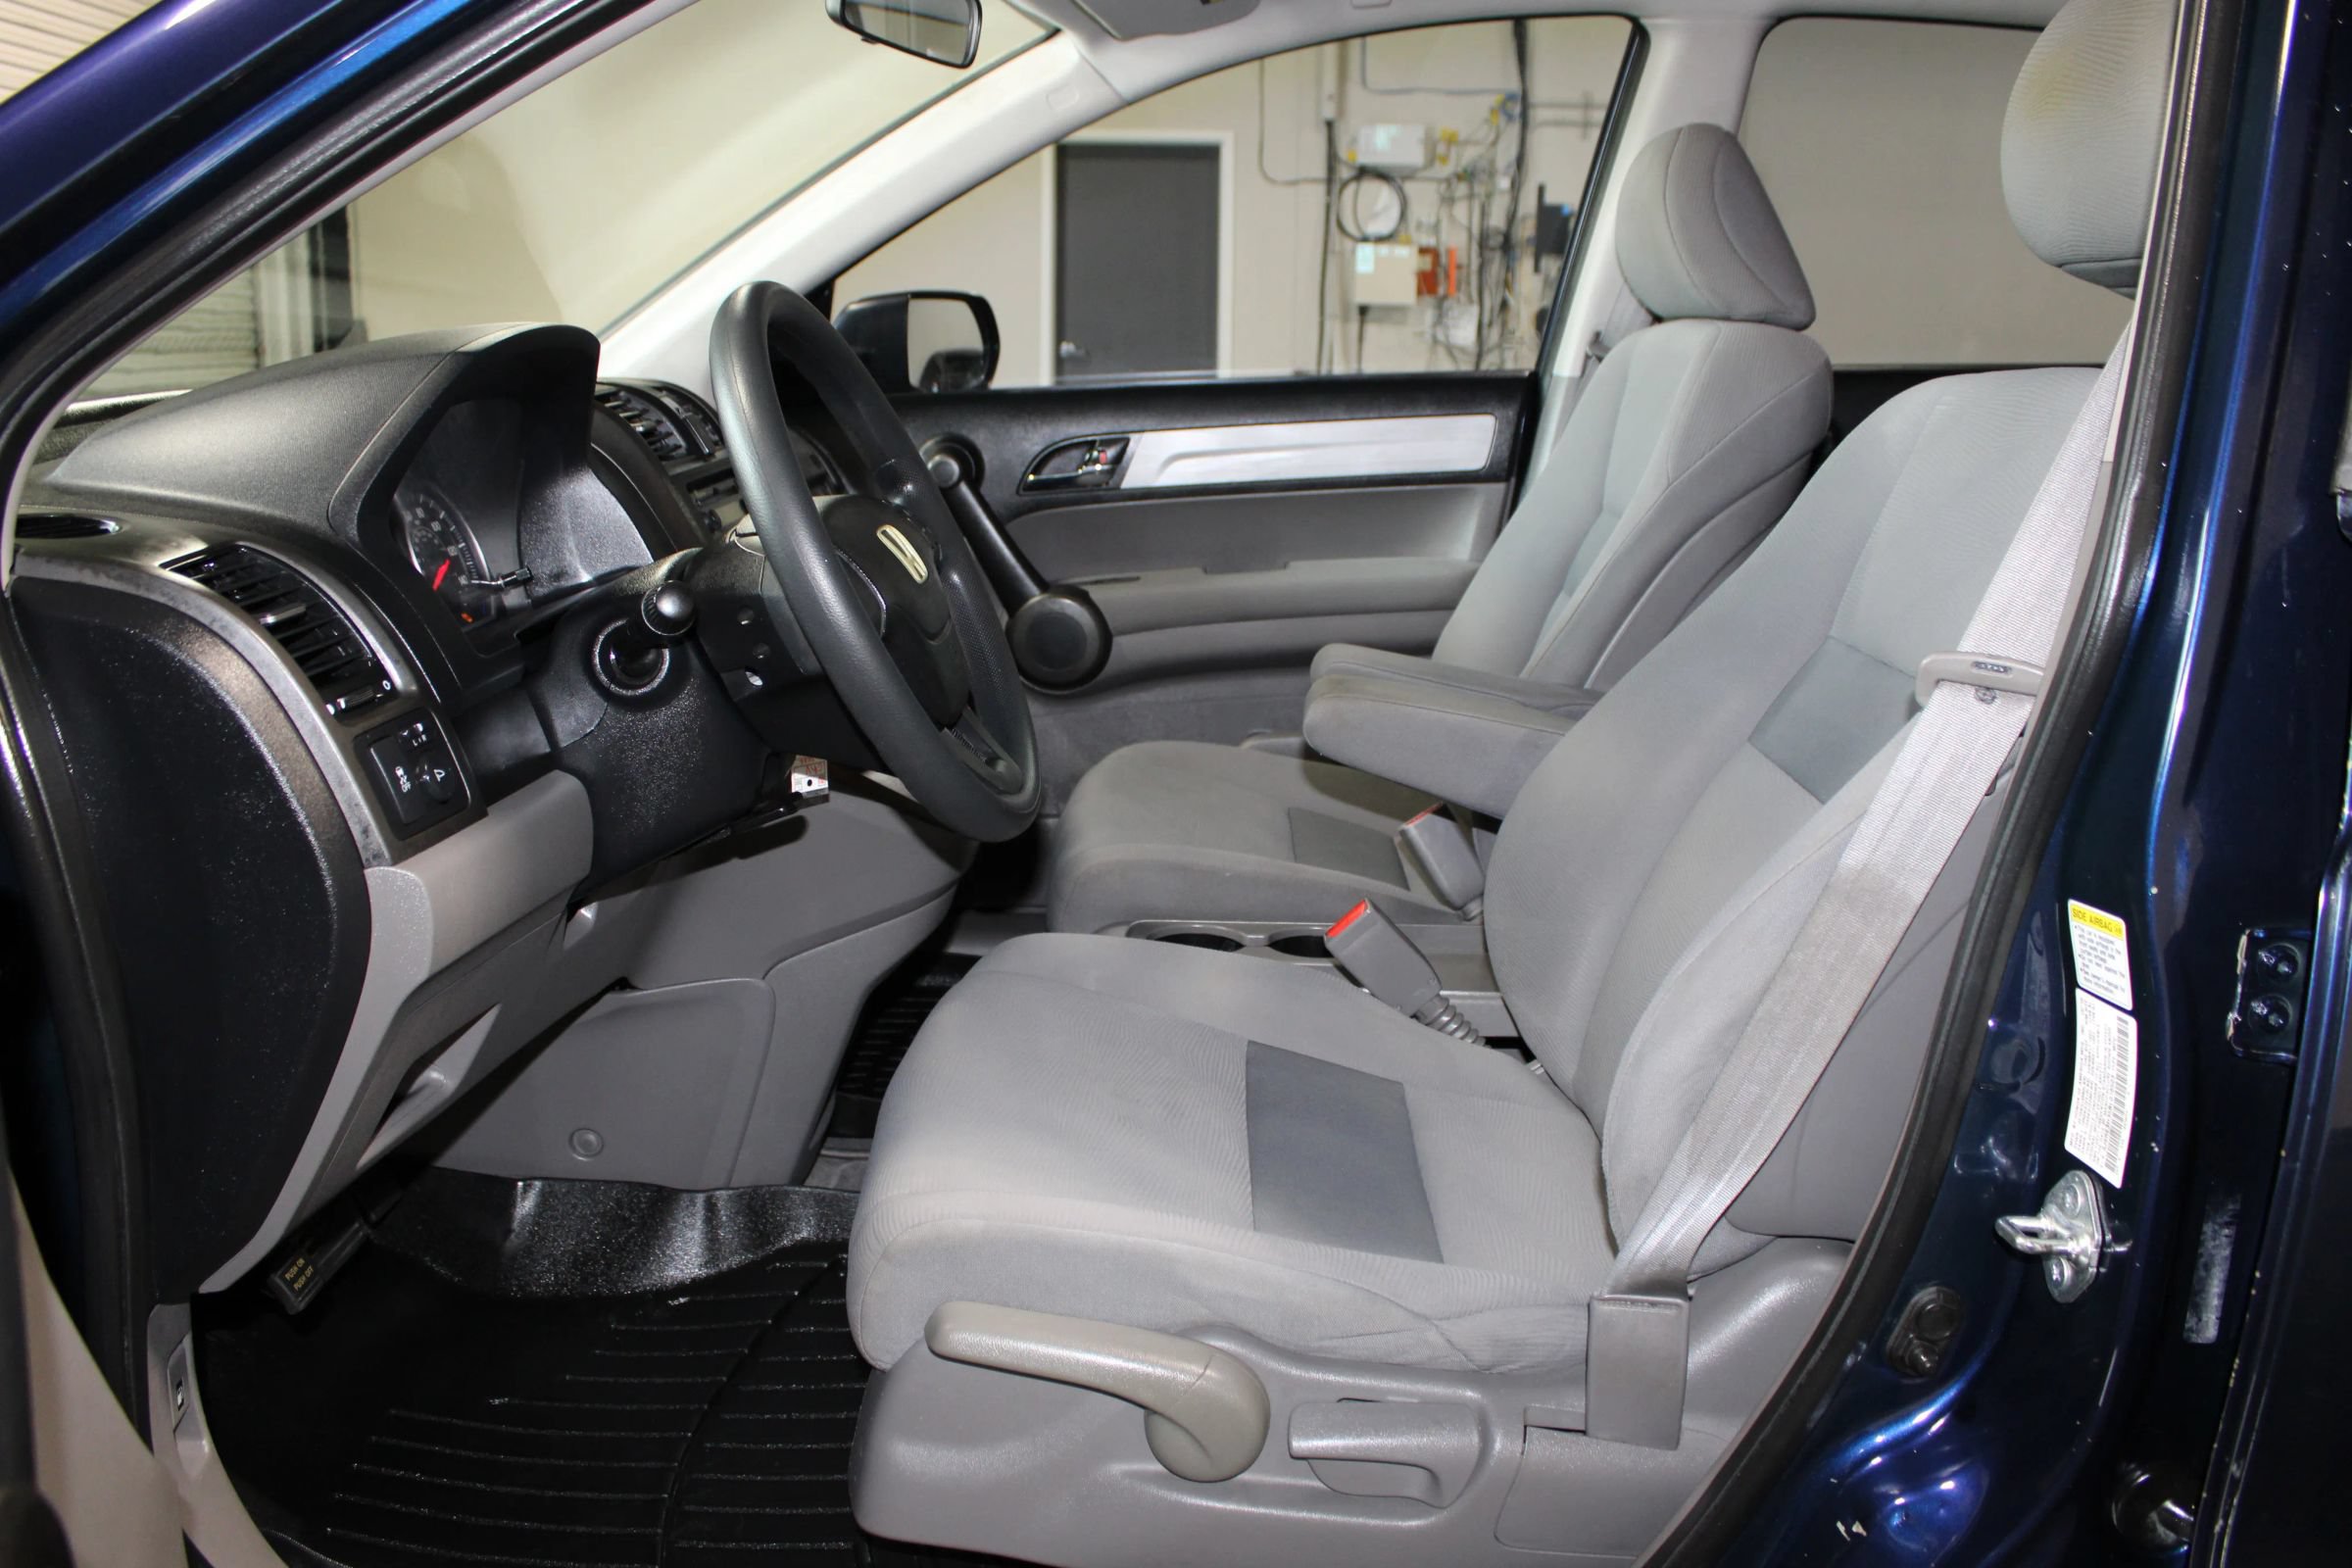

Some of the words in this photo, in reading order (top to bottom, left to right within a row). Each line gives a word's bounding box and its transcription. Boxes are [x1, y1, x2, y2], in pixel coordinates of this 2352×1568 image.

[2072, 907, 2086, 922] SIDE
[2088, 914, 2113, 933] AIRBAG
[284, 1265, 299, 1282] PUSH
[296, 1257, 306, 1268] ON
[293, 1275, 307, 1291] PUSH
[305, 1265, 315, 1279] OFF
